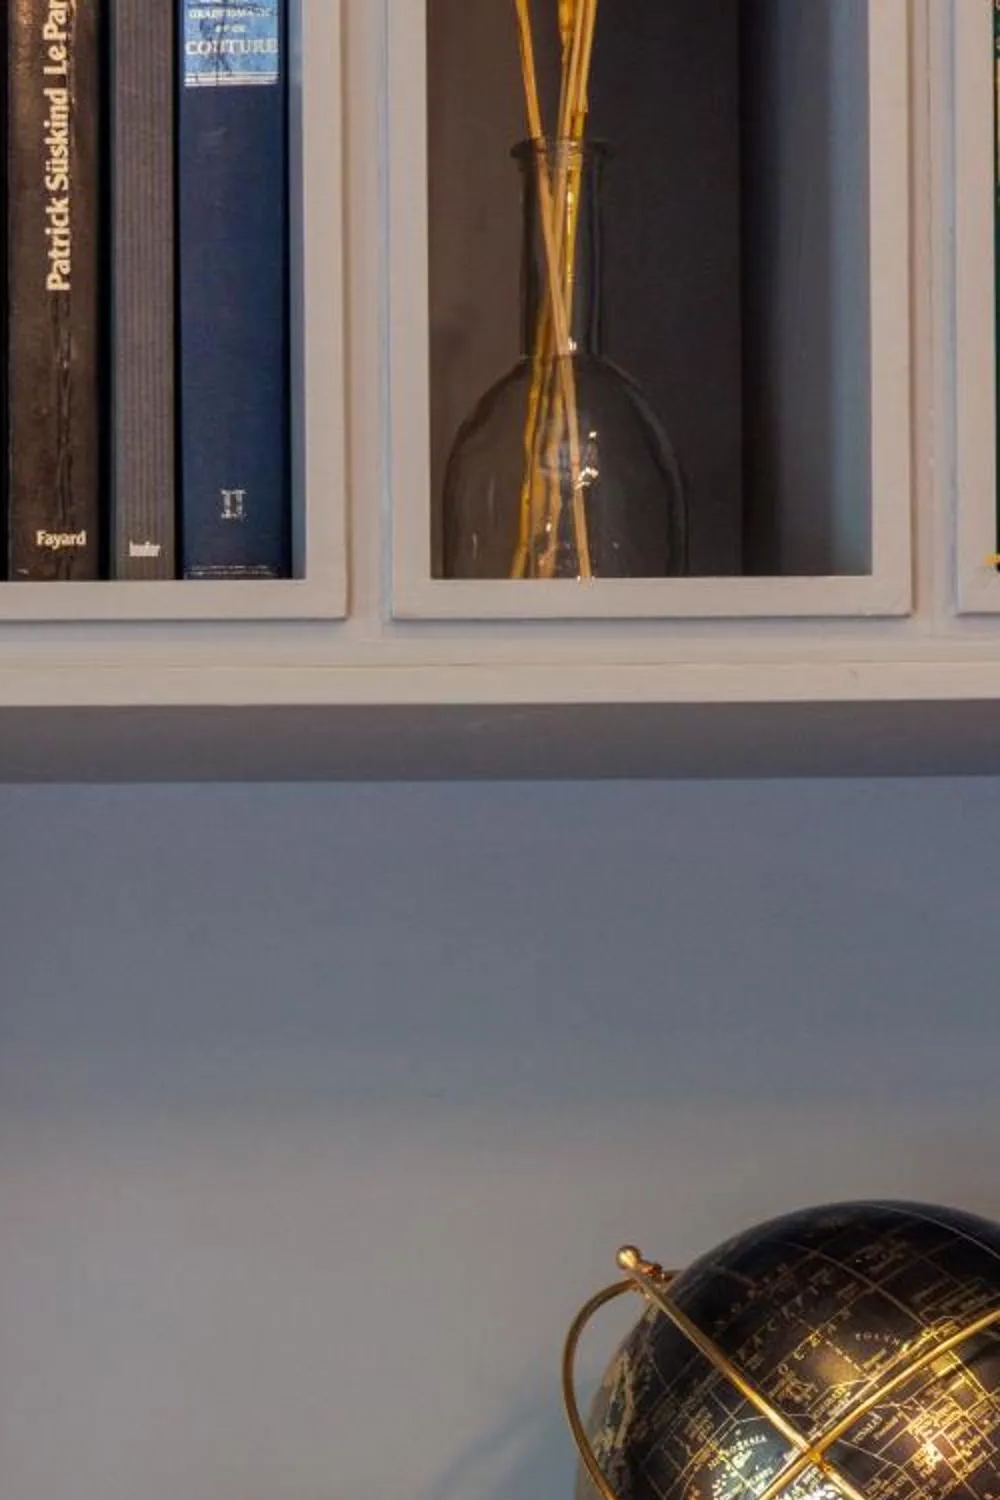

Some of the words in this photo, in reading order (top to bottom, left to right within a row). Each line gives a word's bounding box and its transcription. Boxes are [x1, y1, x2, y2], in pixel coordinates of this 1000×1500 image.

[43, 46, 68, 76] Le
[43, 88, 70, 191] Süskind
[45, 195, 71, 292] Patrick
[35, 529, 87, 550] Fayard
